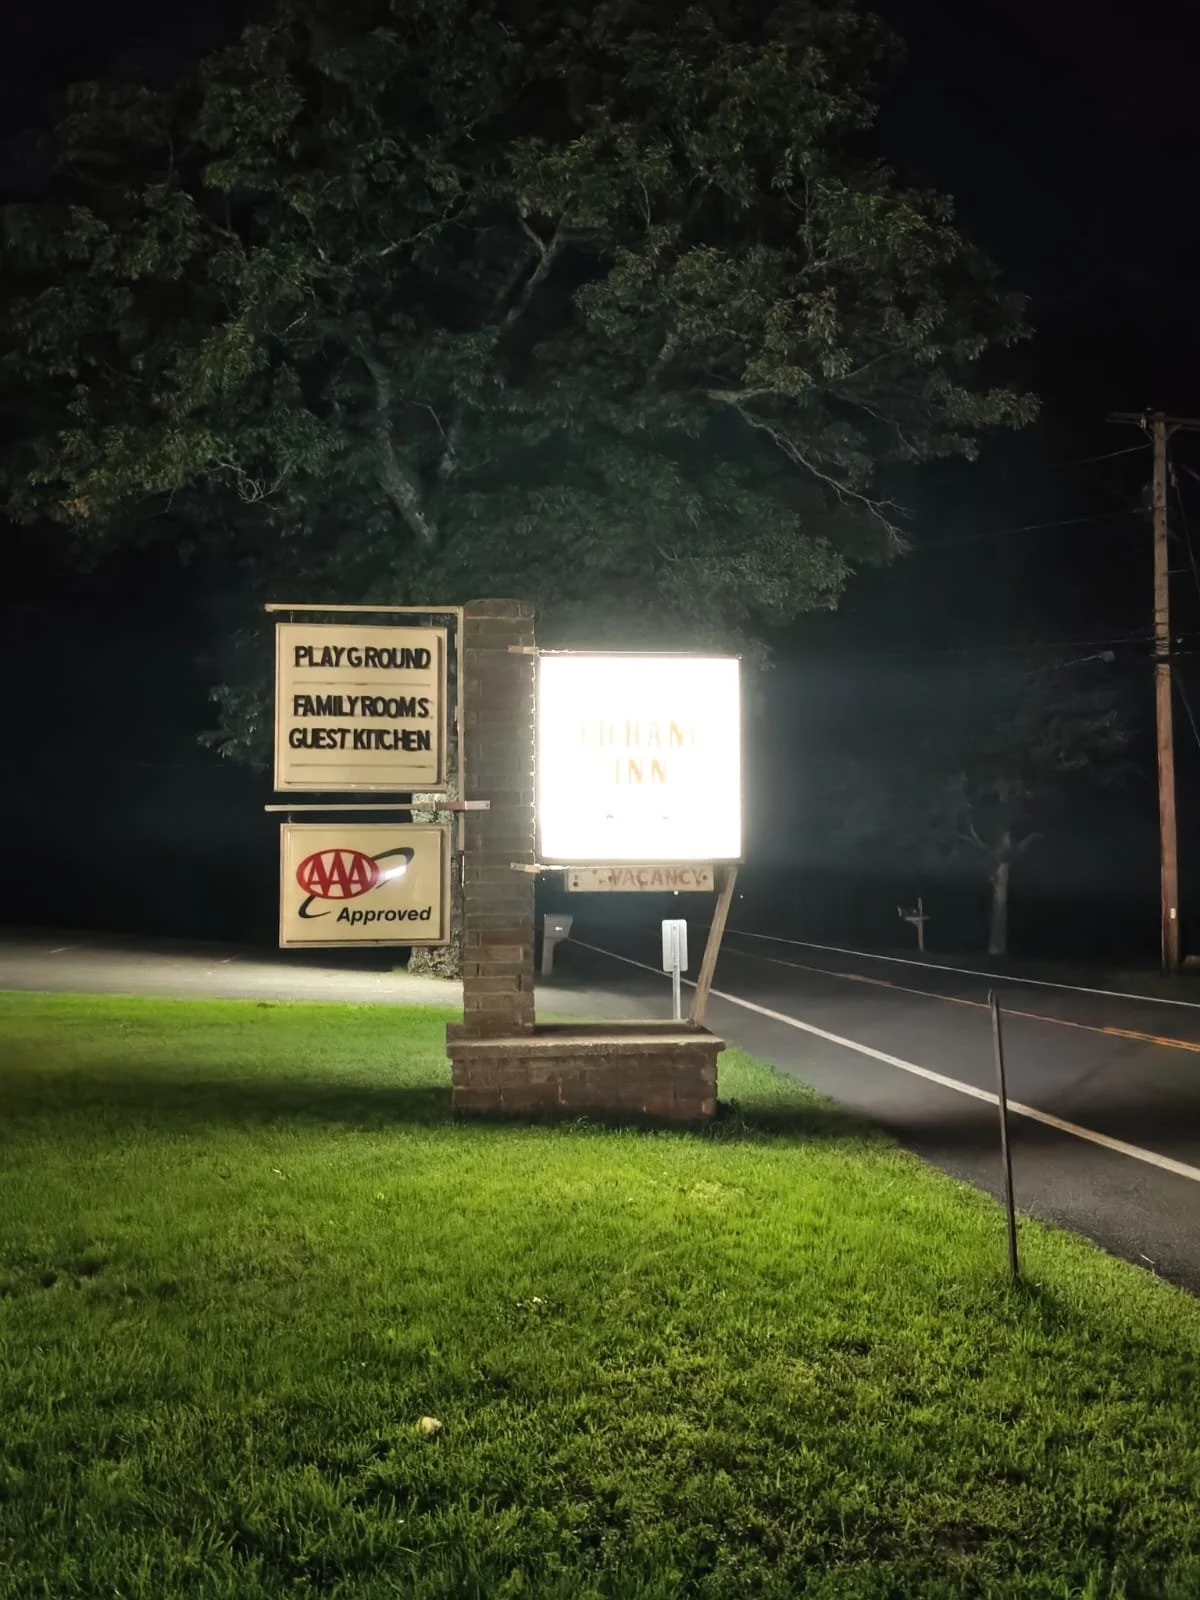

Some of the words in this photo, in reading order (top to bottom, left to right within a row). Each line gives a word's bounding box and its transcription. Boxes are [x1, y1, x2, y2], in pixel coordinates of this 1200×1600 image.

[294, 645, 431, 669] PLAYGROUND
[293, 694, 360, 717] FAMILY
[361, 696, 430, 719] ROOMS
[288, 727, 350, 749] GUEST
[352, 728, 431, 752] KITCHEN
[615, 758, 667, 785] INN
[302, 850, 373, 899] AAA
[610, 868, 704, 888] VACANCY
[336, 906, 432, 926] Approved
